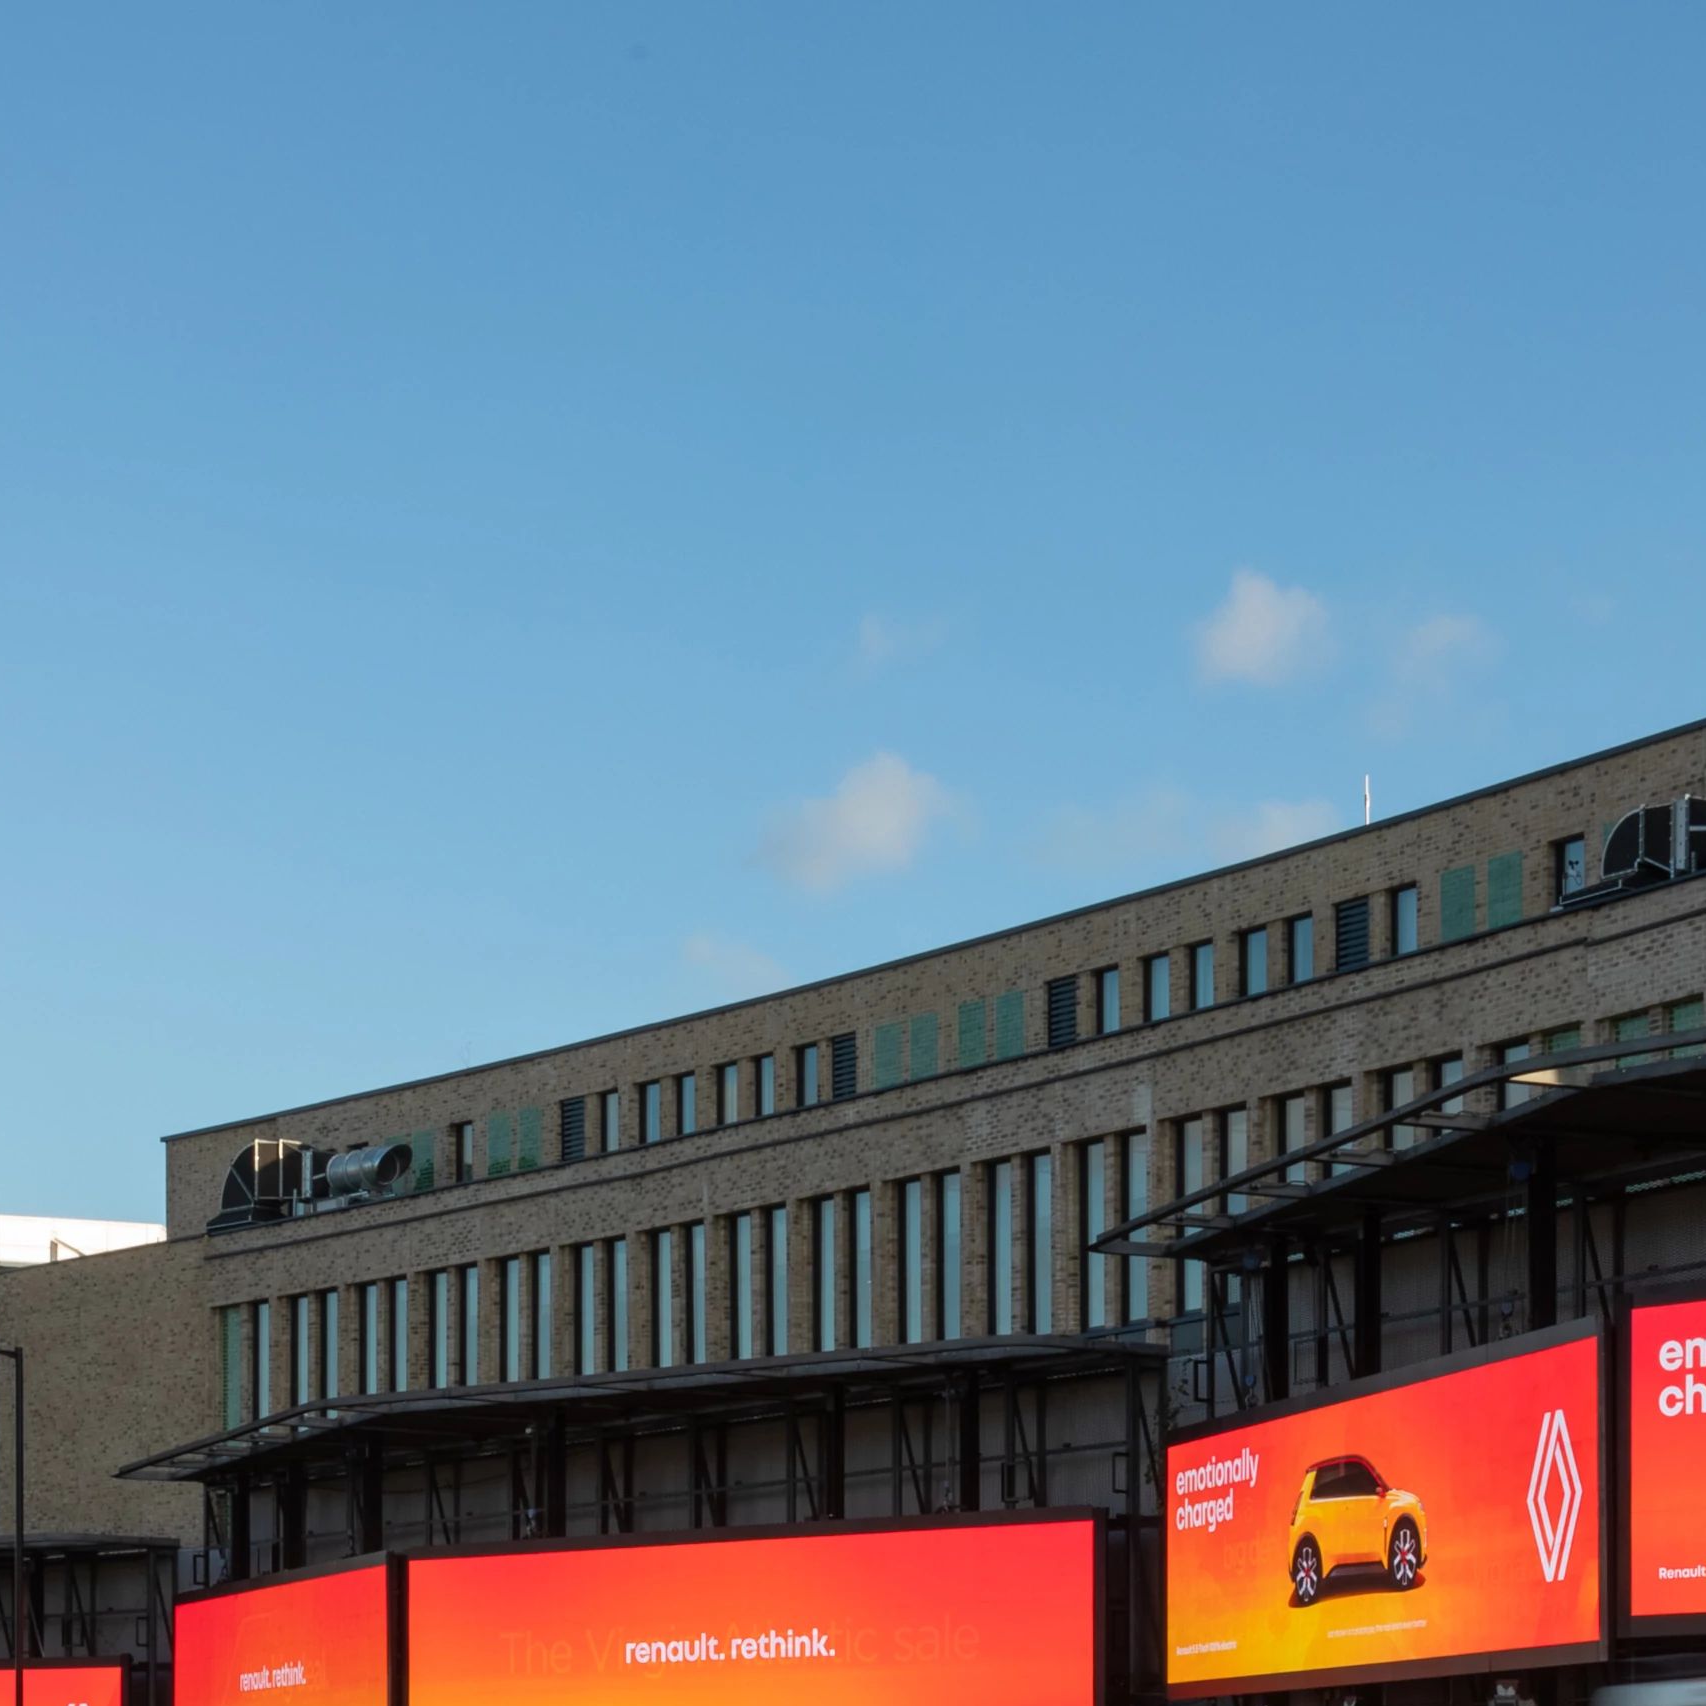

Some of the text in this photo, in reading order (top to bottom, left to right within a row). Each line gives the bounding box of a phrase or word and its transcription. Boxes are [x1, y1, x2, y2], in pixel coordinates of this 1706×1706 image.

[1176, 1447, 1259, 1495] emotionally
[1176, 1487, 1234, 1533] charged
[1658, 1564, 1706, 1580] Renault
[625, 1632, 725, 1664] renault.
[731, 1628, 835, 1660] rethink.
